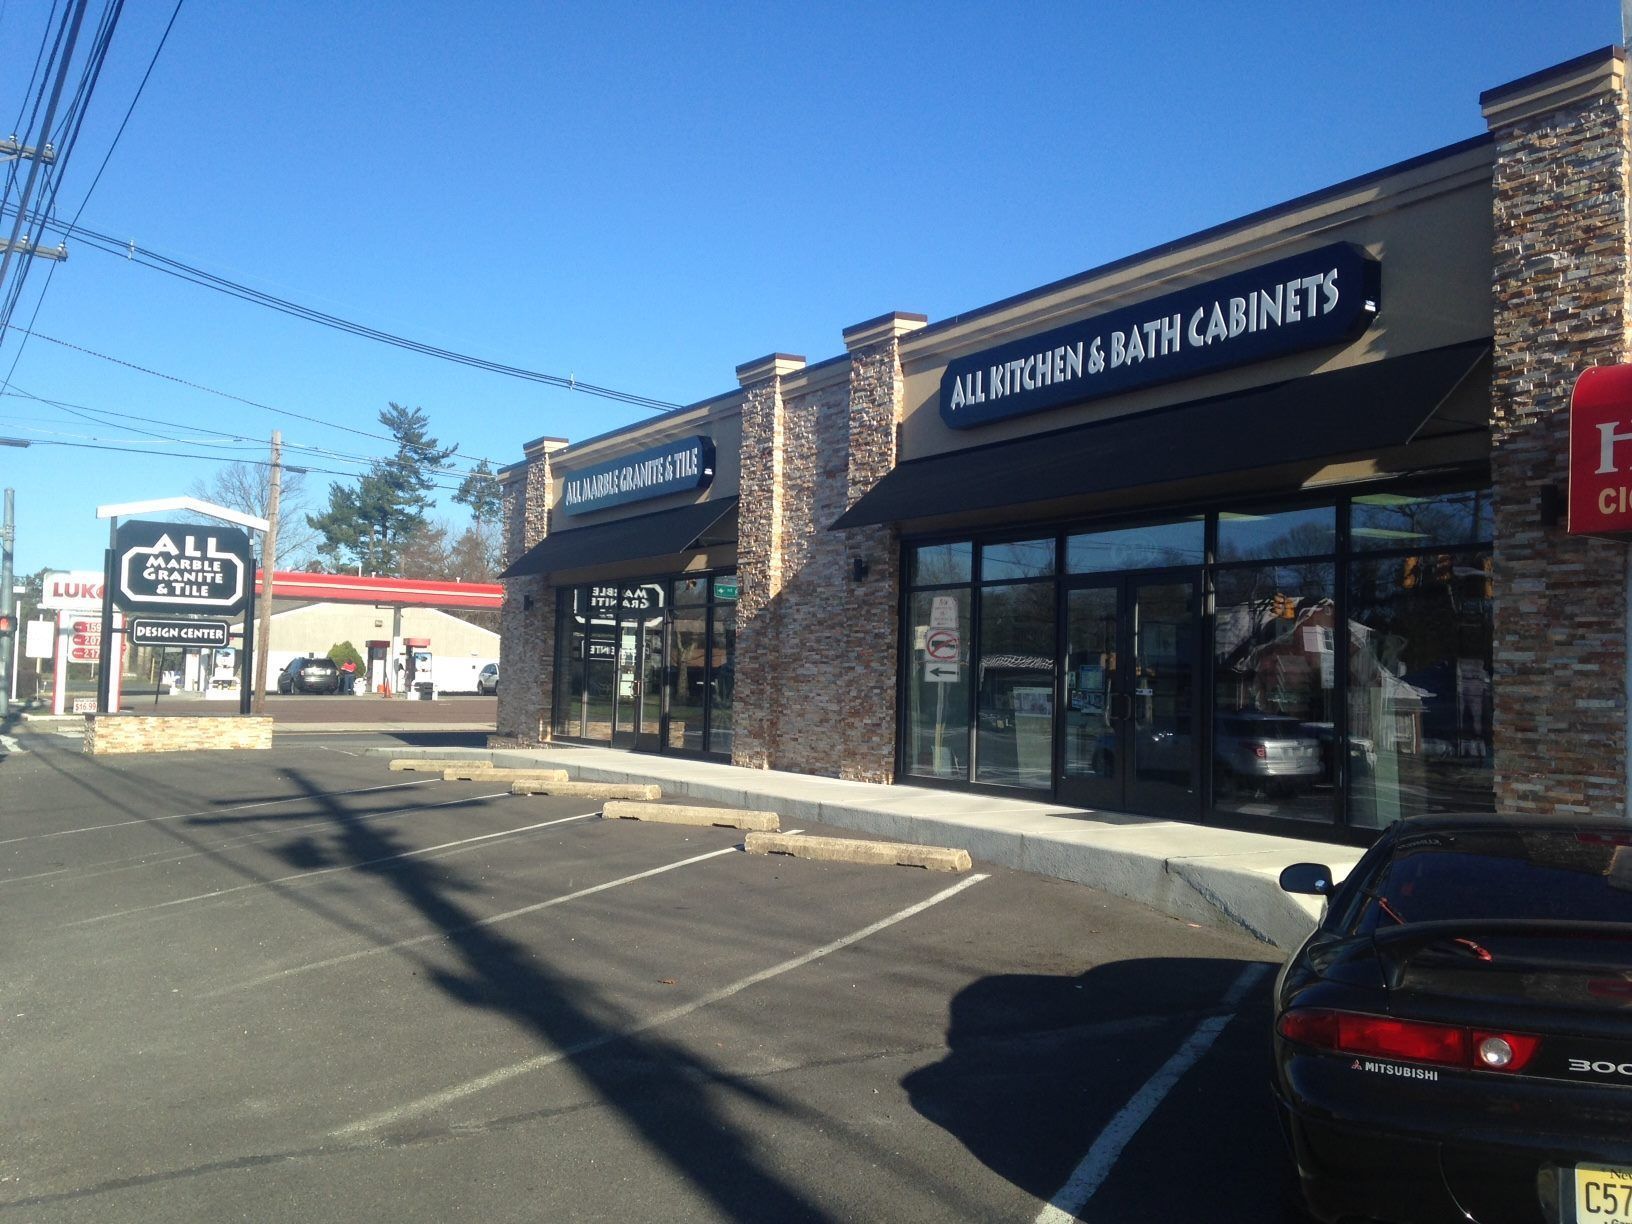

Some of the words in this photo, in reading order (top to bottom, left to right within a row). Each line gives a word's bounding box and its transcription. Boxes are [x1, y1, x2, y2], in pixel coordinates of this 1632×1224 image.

[950, 375, 985, 411] ALL
[989, 342, 1083, 400] KITCHEN
[1087, 336, 1106, 374] &
[1110, 313, 1181, 369] BATH
[1188, 268, 1340, 348] CABINETS
[566, 480, 581, 506] ALL
[582, 469, 619, 502] MARBLE
[620, 457, 664, 492] GRANITE
[665, 454, 673, 482] &
[674, 447, 698, 478] TILE
[1598, 486, 1632, 515] CI
[151, 533, 223, 558] ALL
[145, 555, 221, 571] MARBLE
[142, 567, 223, 584] GRANITE
[156, 583, 168, 595] &
[171, 582, 209, 597] TILE
[136, 626, 179, 638] DESIGN
[180, 628, 223, 639] CENTER
[1365, 1061, 1438, 1081] MITSUBISHI
